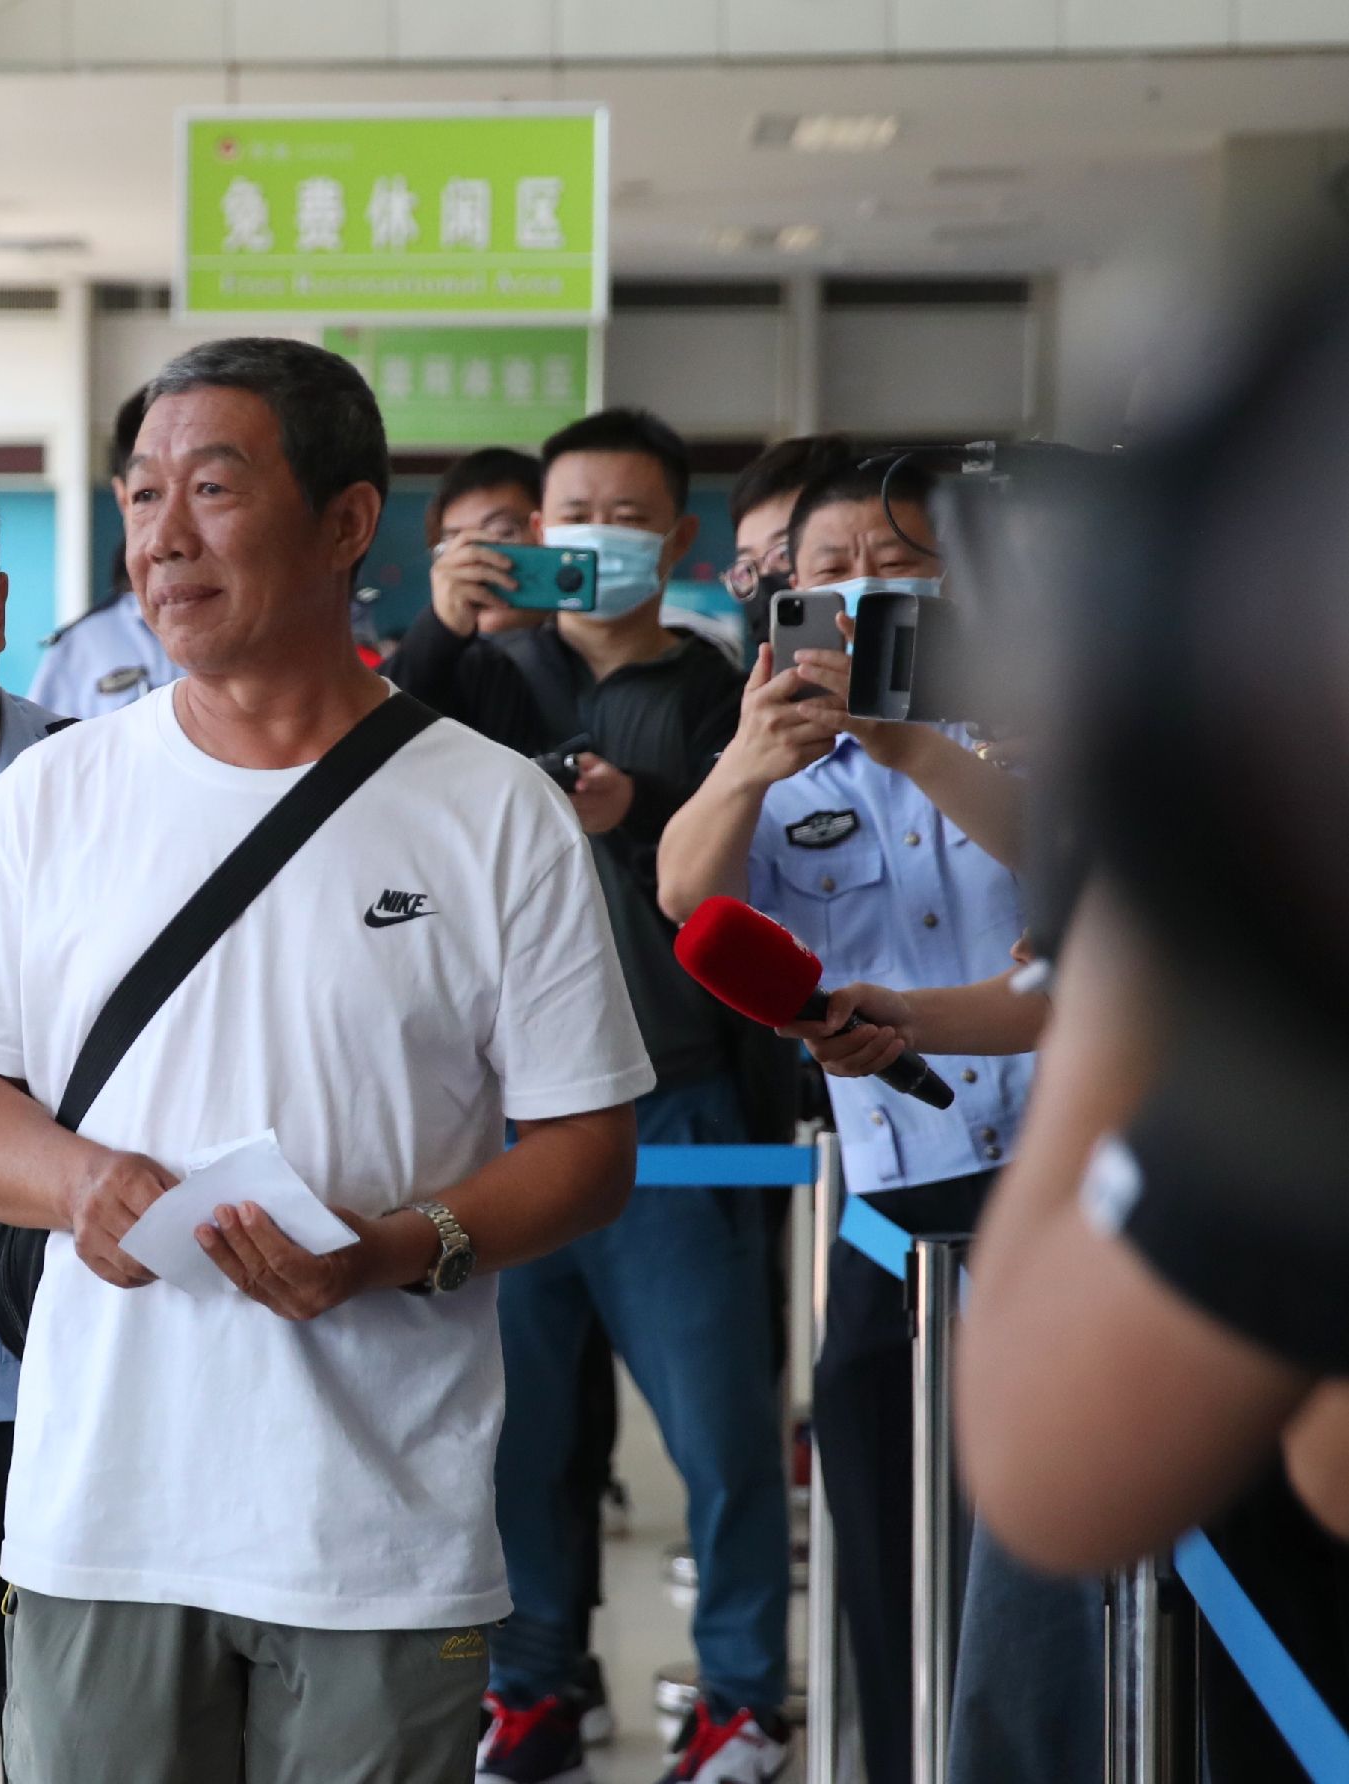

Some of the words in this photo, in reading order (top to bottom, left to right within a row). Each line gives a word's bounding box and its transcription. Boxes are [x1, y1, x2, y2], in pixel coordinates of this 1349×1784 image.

[221, 175, 566, 253] 免费休闲区
[376, 889, 428, 914] NIKE
